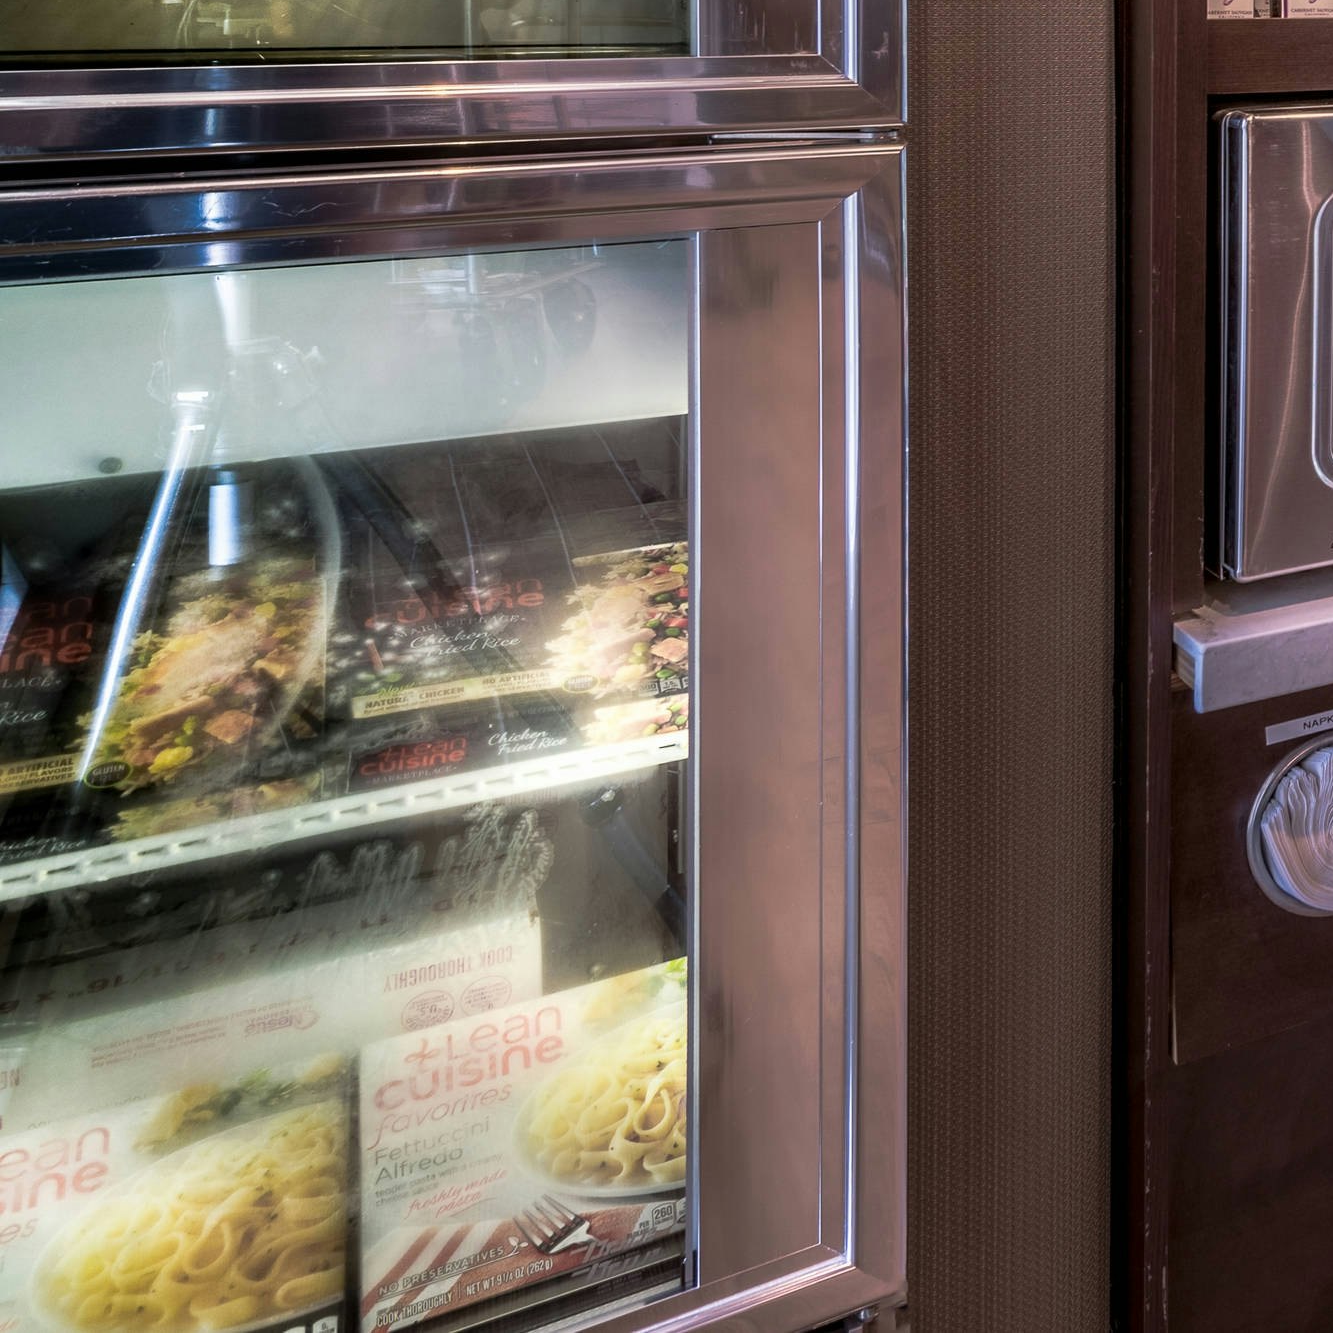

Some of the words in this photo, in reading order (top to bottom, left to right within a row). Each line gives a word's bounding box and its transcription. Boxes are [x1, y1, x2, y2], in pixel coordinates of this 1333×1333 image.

[482, 636, 521, 652] Rice
[488, 729, 548, 747] Chicken
[538, 736, 568, 749] Rice
[446, 1005, 563, 1060] Lean
[373, 1034, 564, 1112] cuisine
[374, 1116, 491, 1165] Fettuccini
[374, 1147, 464, 1185] Alfredo
[378, 1283, 399, 1296] NO
[402, 1246, 505, 1288] PRESERVATIVES
[376, 1311, 401, 1327] COOK
[401, 1292, 453, 1318] THOROUGHLY
[466, 1282, 482, 1296] NET
